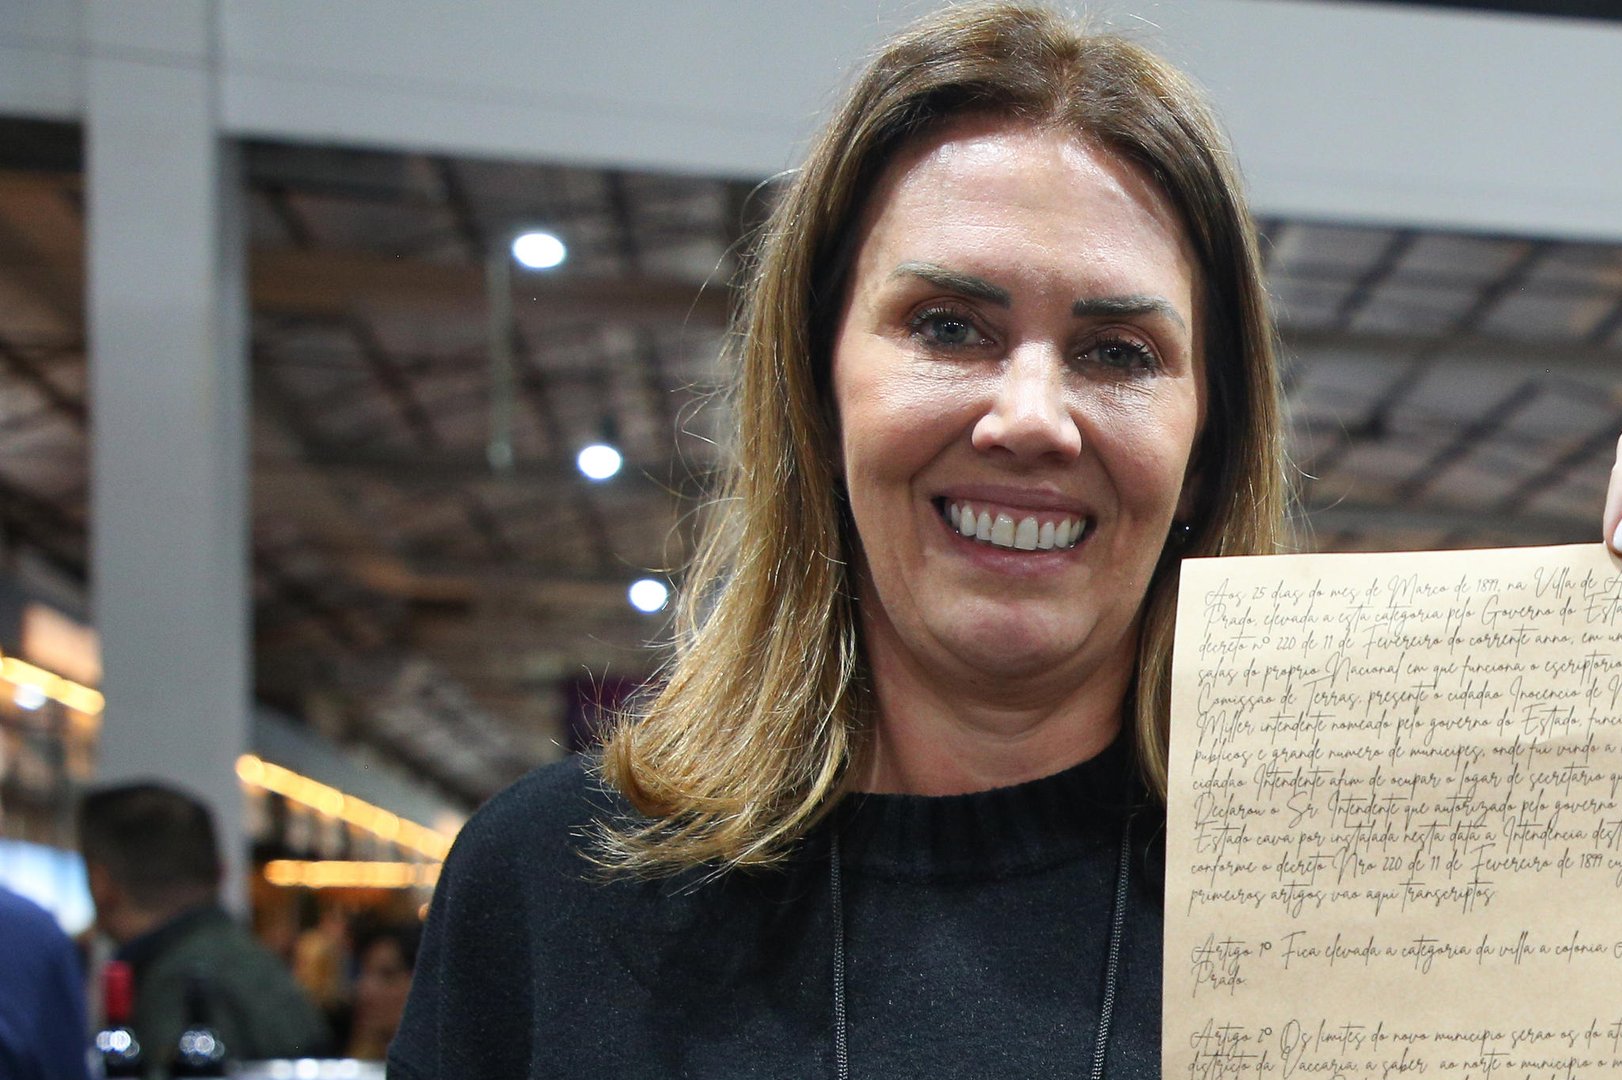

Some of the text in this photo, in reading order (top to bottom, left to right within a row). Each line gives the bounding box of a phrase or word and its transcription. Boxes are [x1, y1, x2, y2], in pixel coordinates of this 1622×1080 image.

[1205, 579, 1242, 606] Aos
[1252, 586, 1267, 599] 25
[1272, 580, 1301, 607] dias
[1309, 579, 1328, 607] do
[1331, 590, 1358, 602] mes
[1365, 578, 1381, 604] de
[1455, 575, 1472, 601] de
[1508, 583, 1527, 591] na
[1535, 567, 1576, 598] Villa
[1581, 569, 1597, 598] de
[1264, 604, 1321, 633] elevada
[1338, 603, 1375, 632] esta
[1375, 602, 1439, 633] categoria
[1445, 597, 1475, 632] pelo
[1481, 595, 1554, 630] Governo
[1560, 597, 1576, 626] do
[1199, 631, 1256, 662] decreto
[1276, 638, 1296, 650] 220
[1302, 630, 1320, 658] de
[1324, 635, 1333, 649] 11
[1338, 627, 1357, 657] de
[1363, 623, 1442, 659] Fevereiro
[1448, 626, 1465, 654] do
[1469, 625, 1539, 657] corrente
[1582, 634, 1604, 643] em
[1194, 791, 1265, 830] Declarou
[1328, 790, 1408, 828] Intendente
[1405, 804, 1429, 832] que
[1434, 792, 1516, 825] autorizado
[1520, 789, 1549, 824] pelo
[1555, 801, 1617, 824] governo
[1188, 886, 1266, 917] primeiros
[1271, 880, 1322, 918] artigos
[1331, 890, 1360, 900] vao
[1367, 890, 1399, 917] aqui
[1191, 932, 1253, 975] Artigo
[1280, 931, 1321, 969] Fica
[1325, 933, 1381, 966] elevada
[1385, 947, 1397, 956] a
[1401, 935, 1473, 974] categoria
[1476, 934, 1494, 965] da
[1500, 931, 1537, 964] villa
[1555, 930, 1608, 963] colonia
